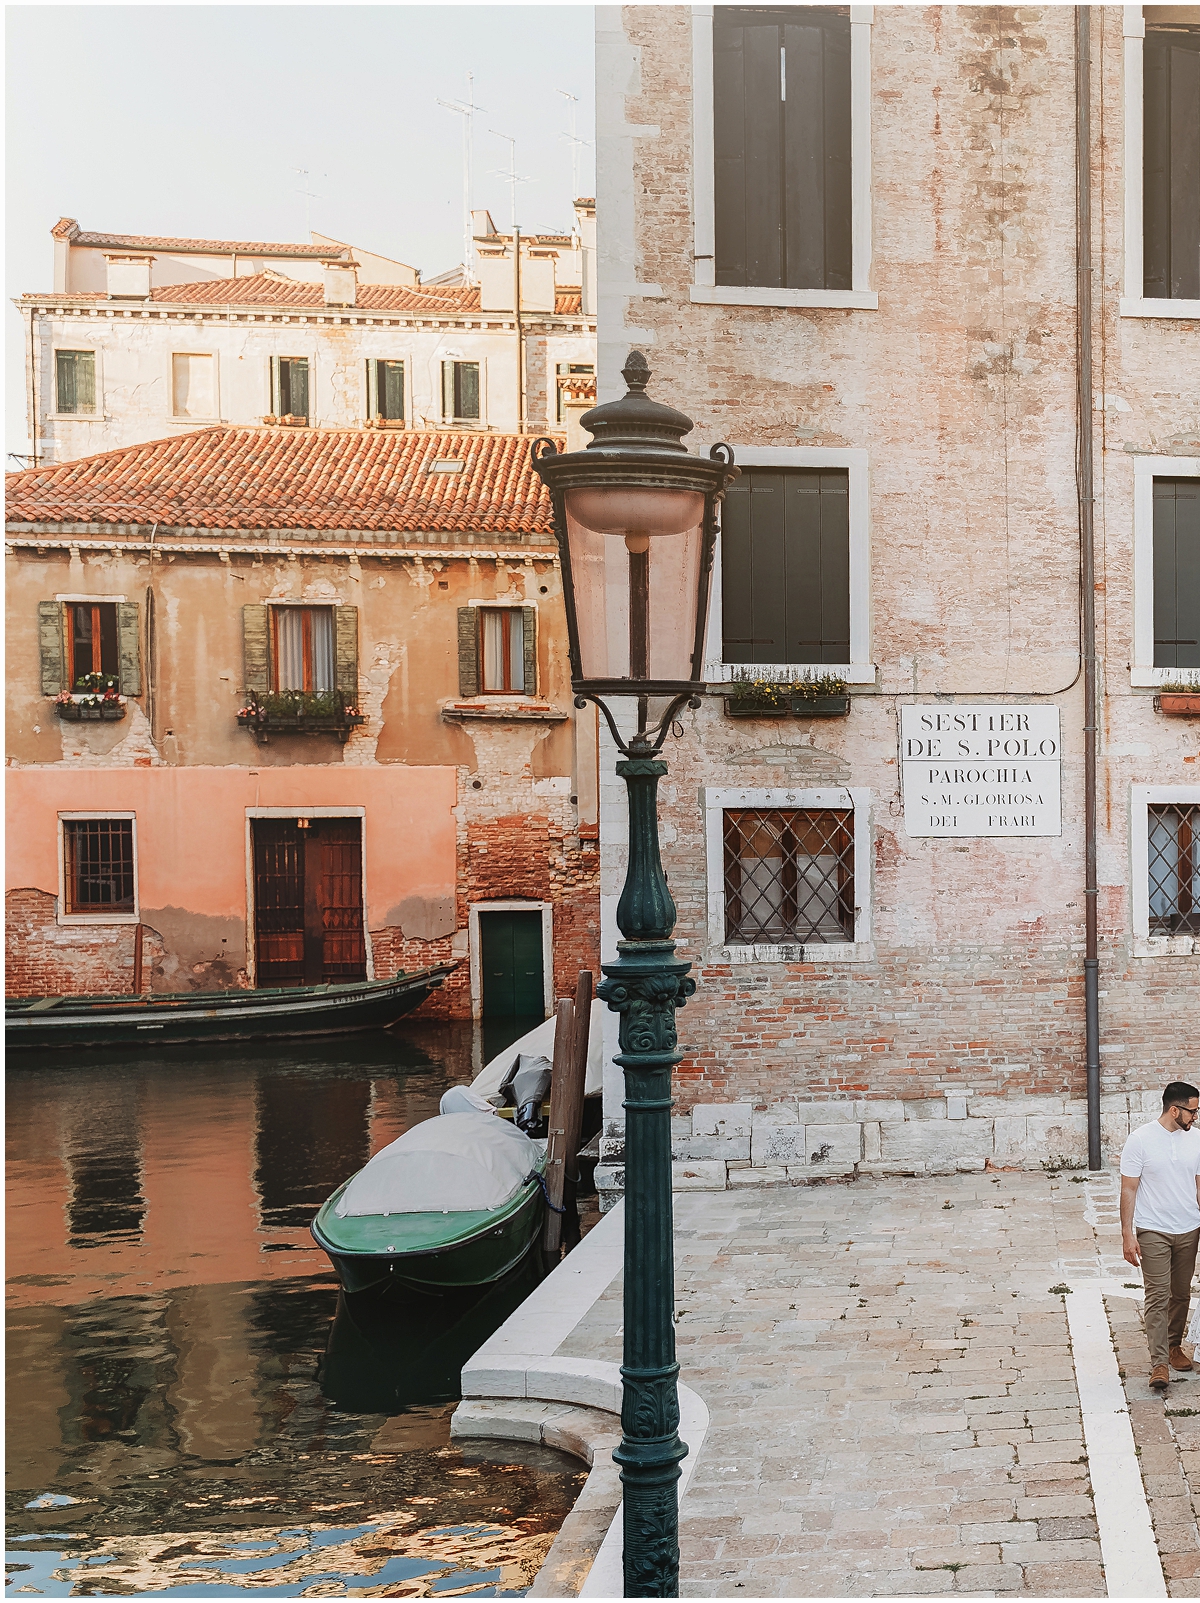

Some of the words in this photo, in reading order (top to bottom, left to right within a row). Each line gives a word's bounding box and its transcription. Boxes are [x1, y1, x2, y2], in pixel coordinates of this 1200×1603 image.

[921, 714, 1030, 731] SESTIER
[907, 739, 941, 756] DE
[929, 769, 1032, 783] PAROCHIA
[930, 816, 957, 827] DEI
[989, 816, 1035, 826] FRARI
